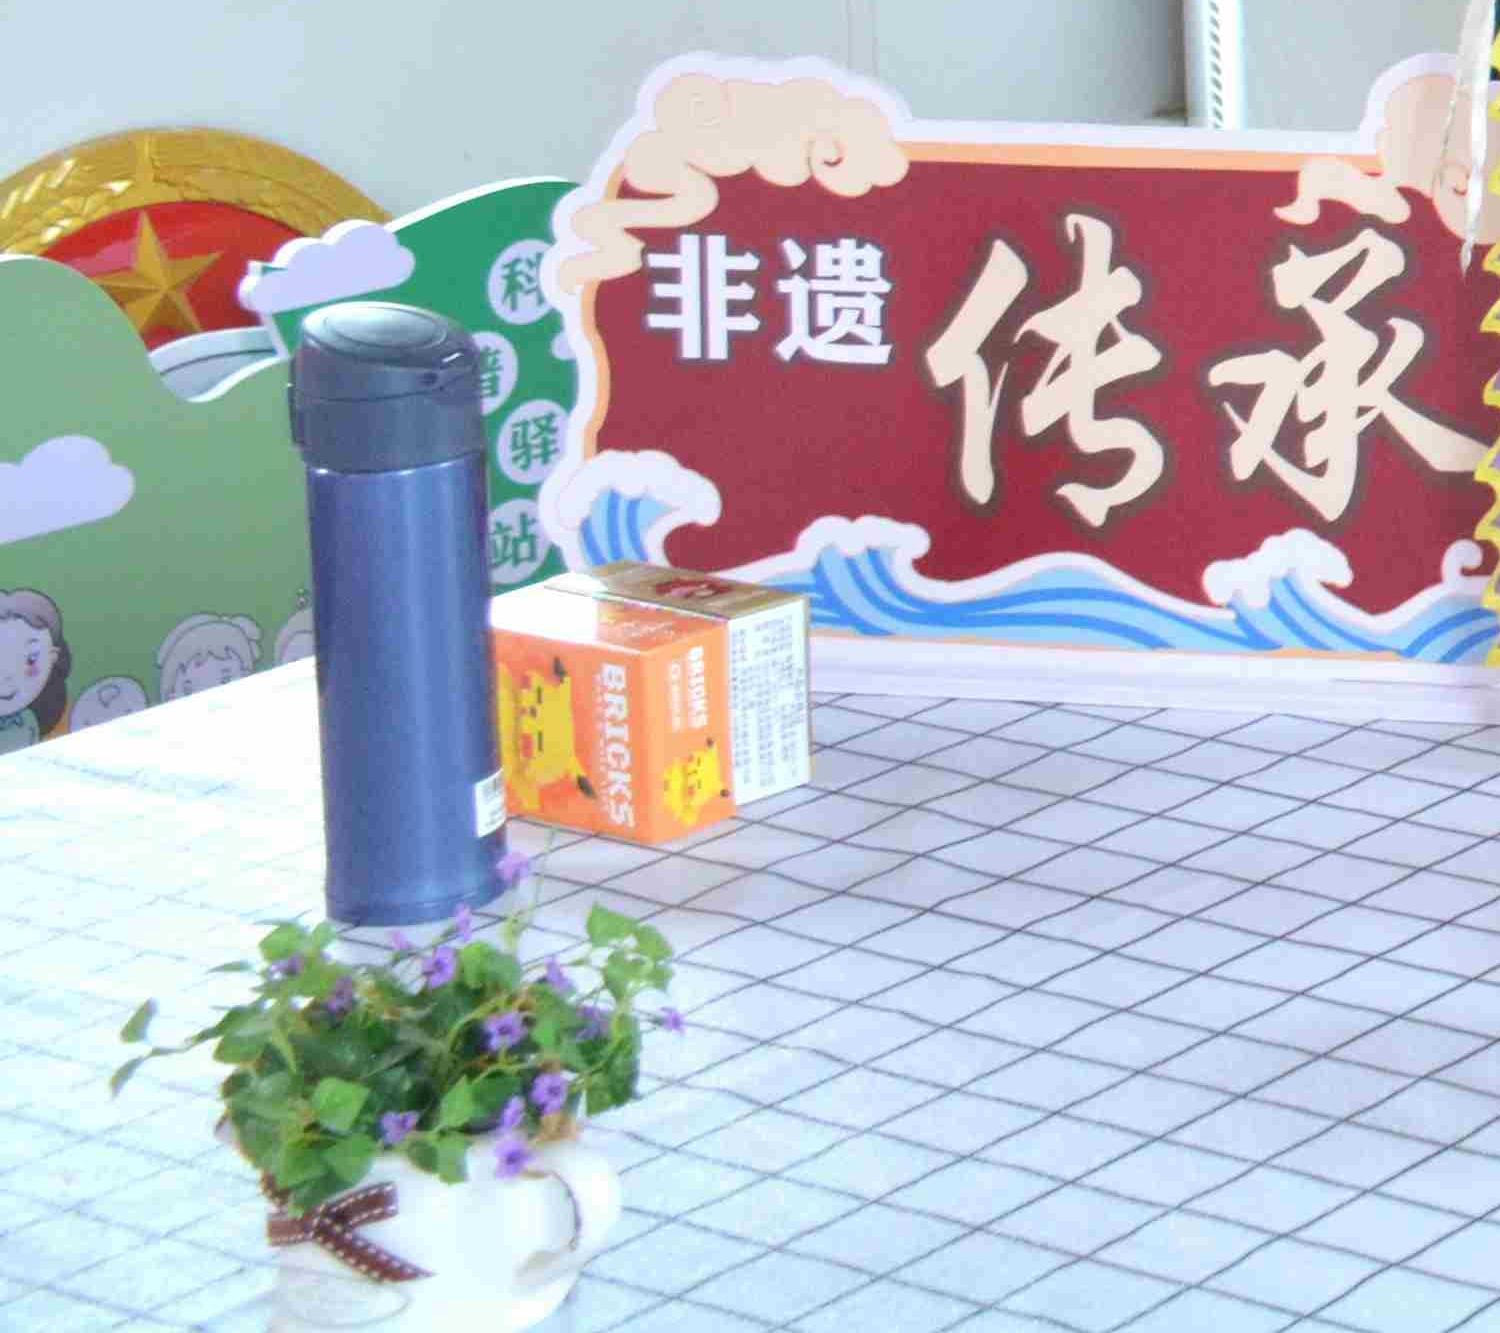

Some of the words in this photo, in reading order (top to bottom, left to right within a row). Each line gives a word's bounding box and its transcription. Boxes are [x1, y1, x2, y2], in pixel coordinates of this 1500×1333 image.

[645, 232, 894, 365] 非遗
[926, 212, 1490, 527] 传承
[599, 661, 635, 828] BRICKS
